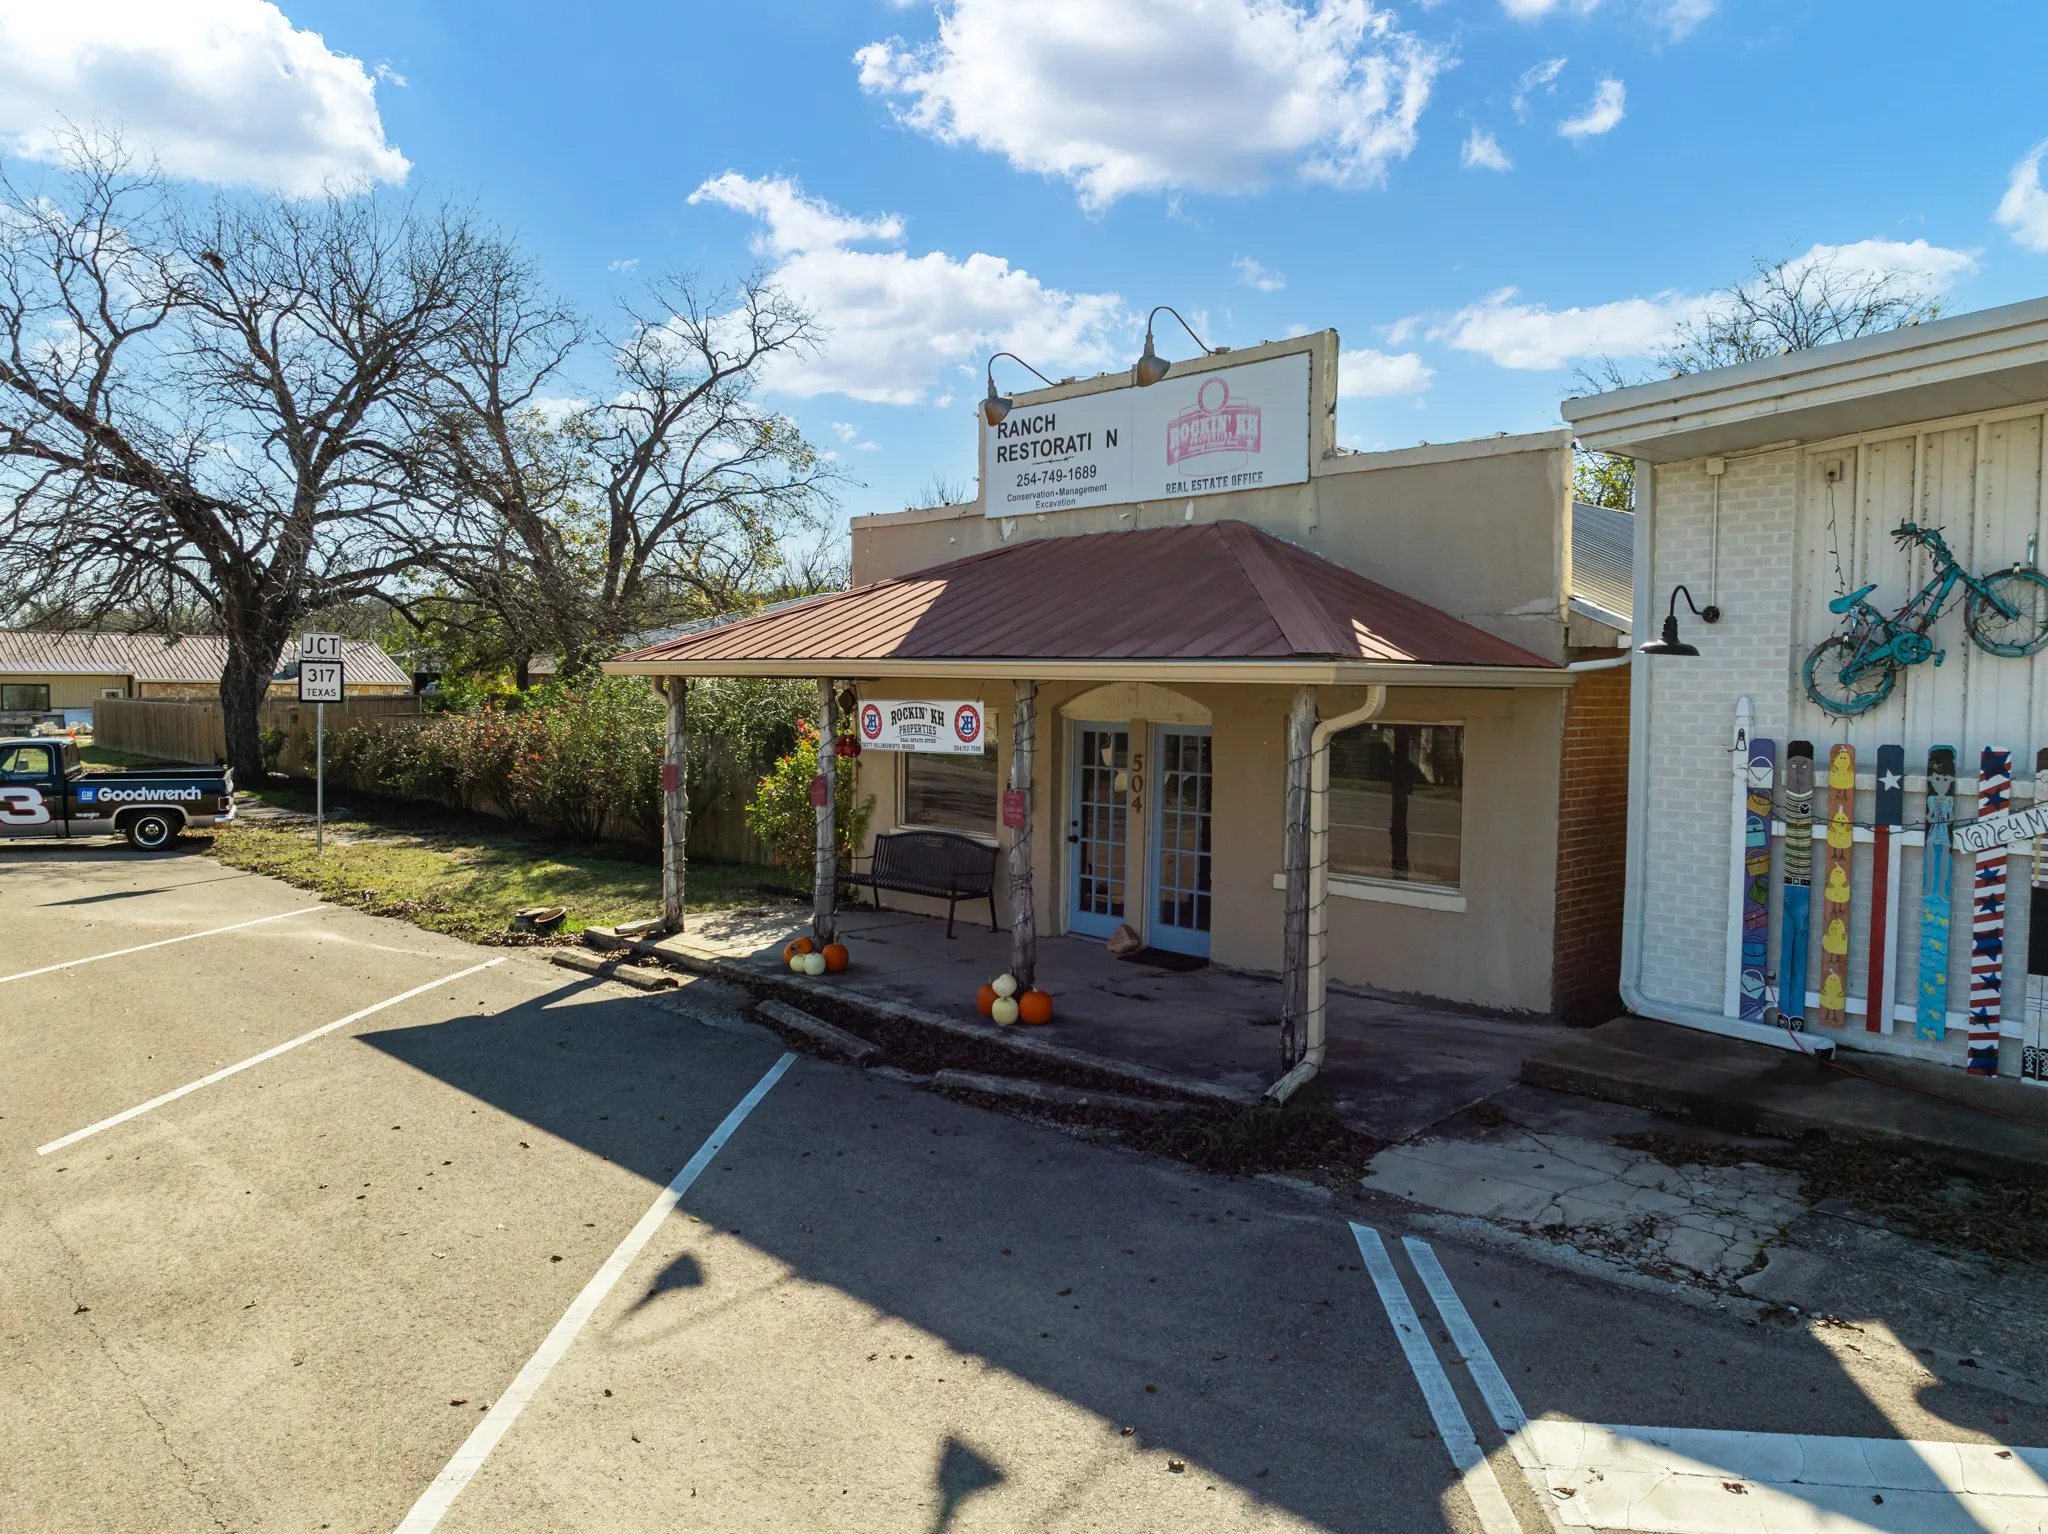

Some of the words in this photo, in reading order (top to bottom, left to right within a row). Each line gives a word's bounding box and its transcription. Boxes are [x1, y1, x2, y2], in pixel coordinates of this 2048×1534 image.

[997, 413, 1056, 440] RANCH
[1016, 464, 1097, 488] 254-749-1689
[1165, 481, 1189, 495] REAL
[1191, 475, 1229, 492] ESTATE
[1231, 471, 1264, 486] OFFICE
[1035, 498, 1076, 509] Excavation
[304, 636, 339, 655] JCT
[307, 668, 335, 683] 317
[306, 688, 337, 697] TEXAS
[890, 706, 928, 726] ROCKIN'
[930, 708, 945, 727] KH
[898, 724, 937, 736] PROPERTIES
[81, 790, 93, 799] GM
[97, 786, 202, 802] Goodwrench
[1131, 754, 1144, 814] 504
[0, 787, 51, 825] 3
[1955, 818, 2027, 853] Valley
[2024, 808, 2048, 836] M
